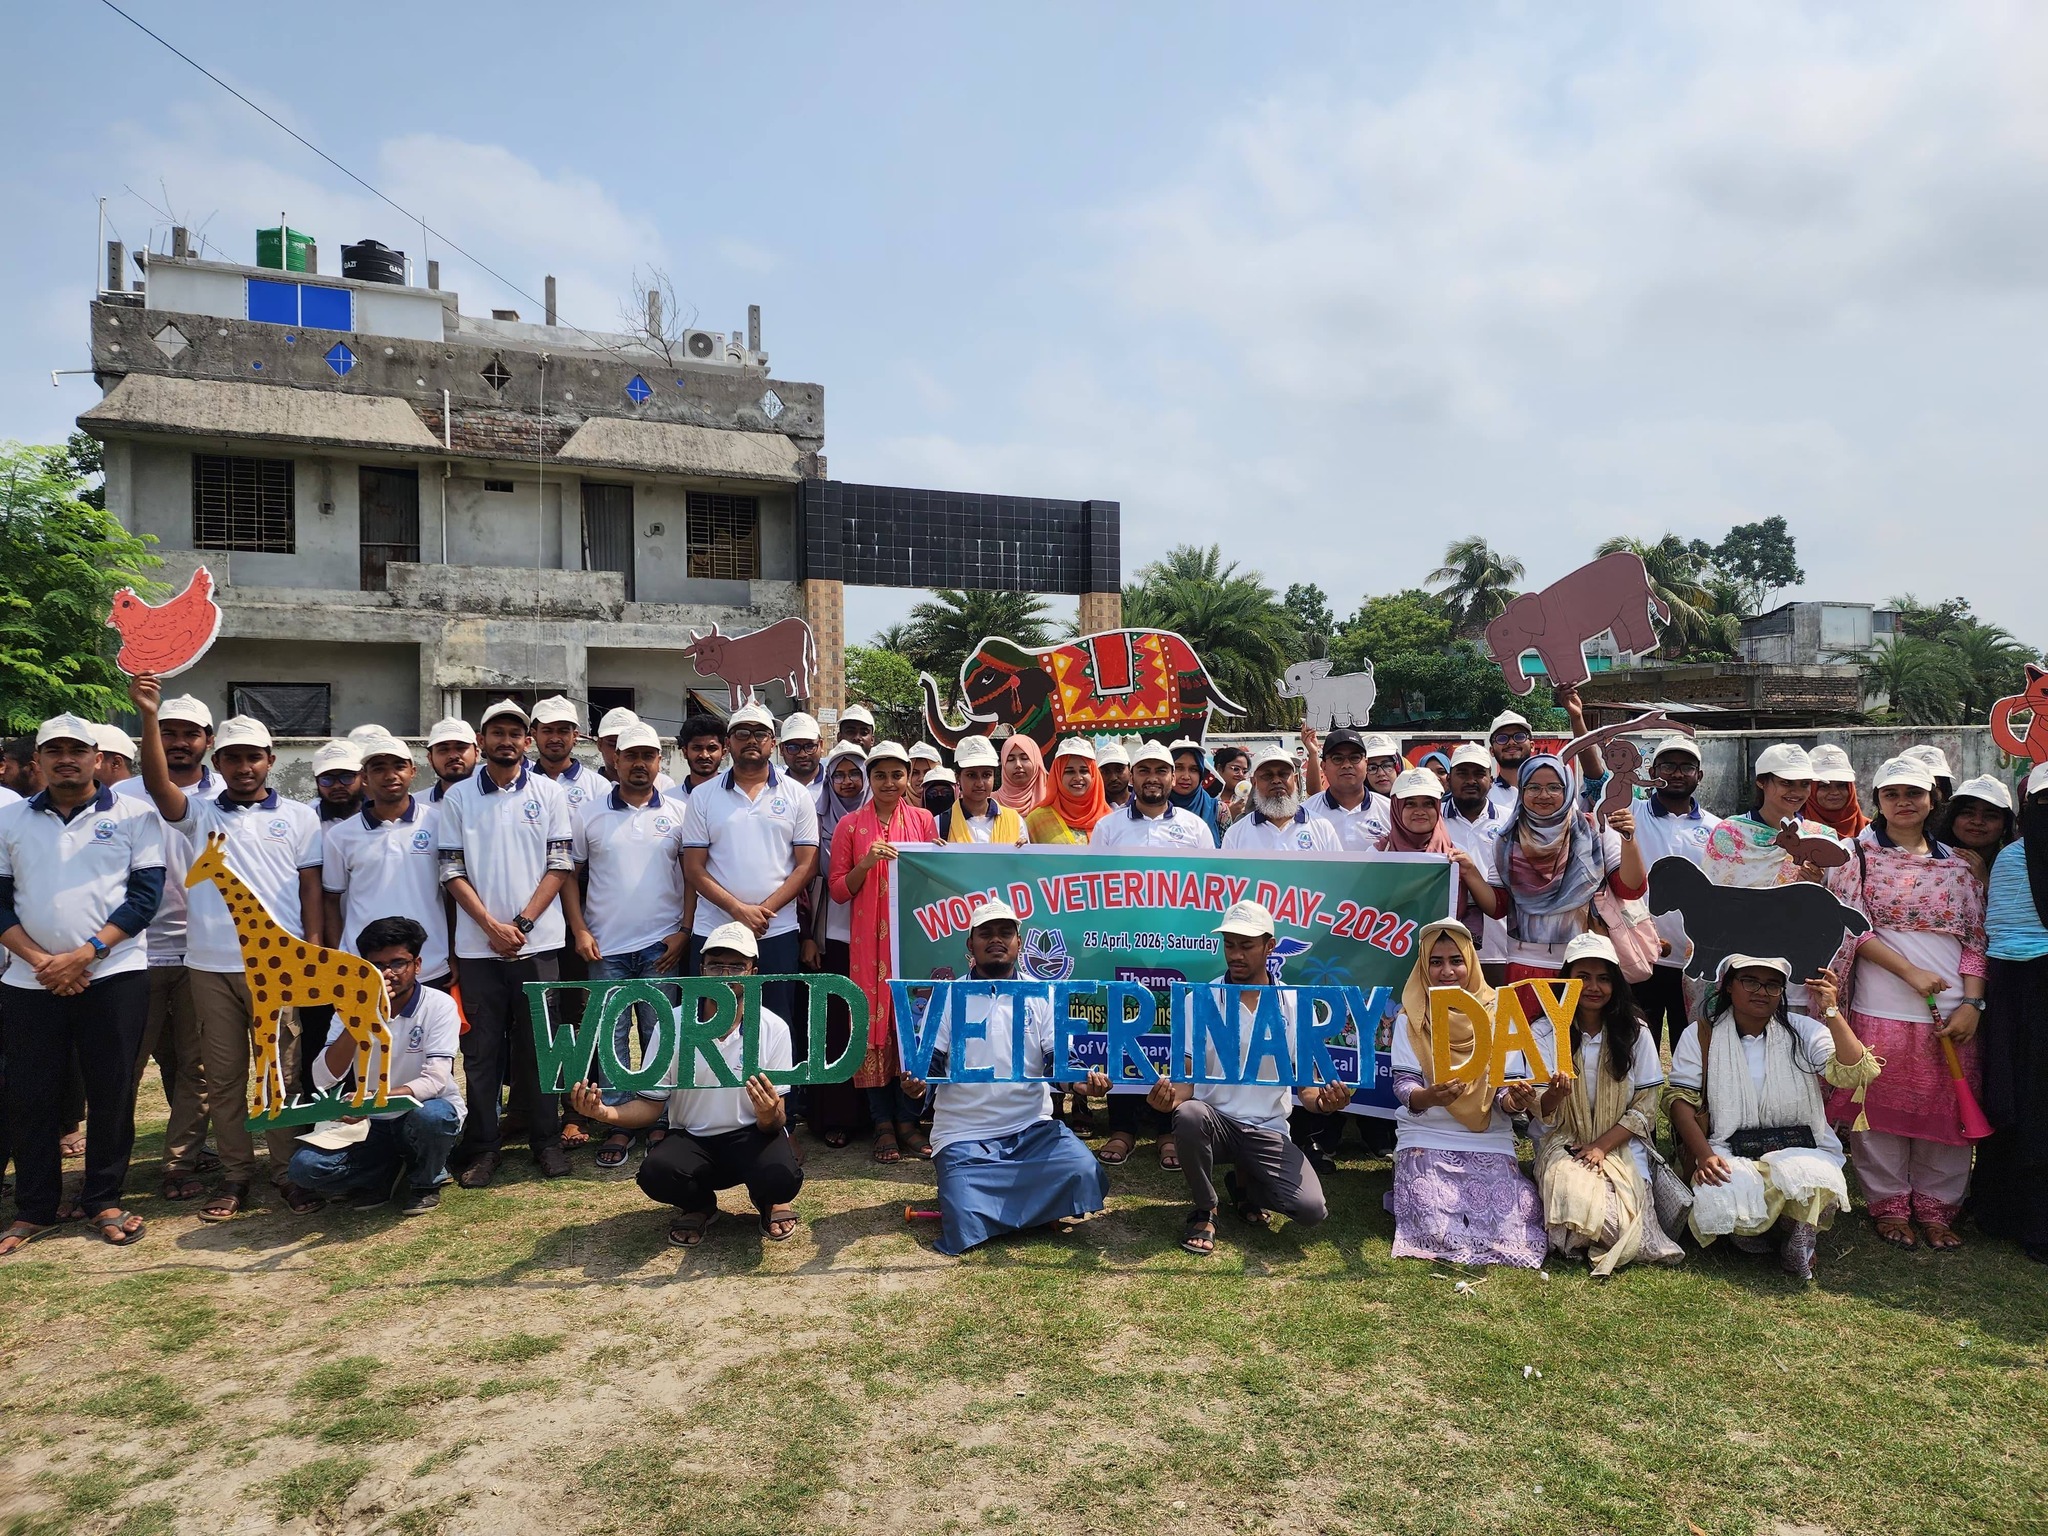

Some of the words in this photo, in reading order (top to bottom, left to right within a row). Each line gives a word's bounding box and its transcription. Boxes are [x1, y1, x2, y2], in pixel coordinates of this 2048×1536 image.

[1037, 869, 1250, 914] VETERINARY
[1256, 879, 1418, 957] DAY-2026
[1084, 931, 1098, 948] 25
[1101, 932, 1131, 951] April,
[1134, 933, 1165, 951] 2026;
[1167, 934, 1219, 955] Saturday
[522, 973, 869, 1093] WORLD
[886, 979, 1394, 1089] VETERINARY
[1078, 1040, 1094, 1055] of
[1428, 978, 1582, 1088] DAY
